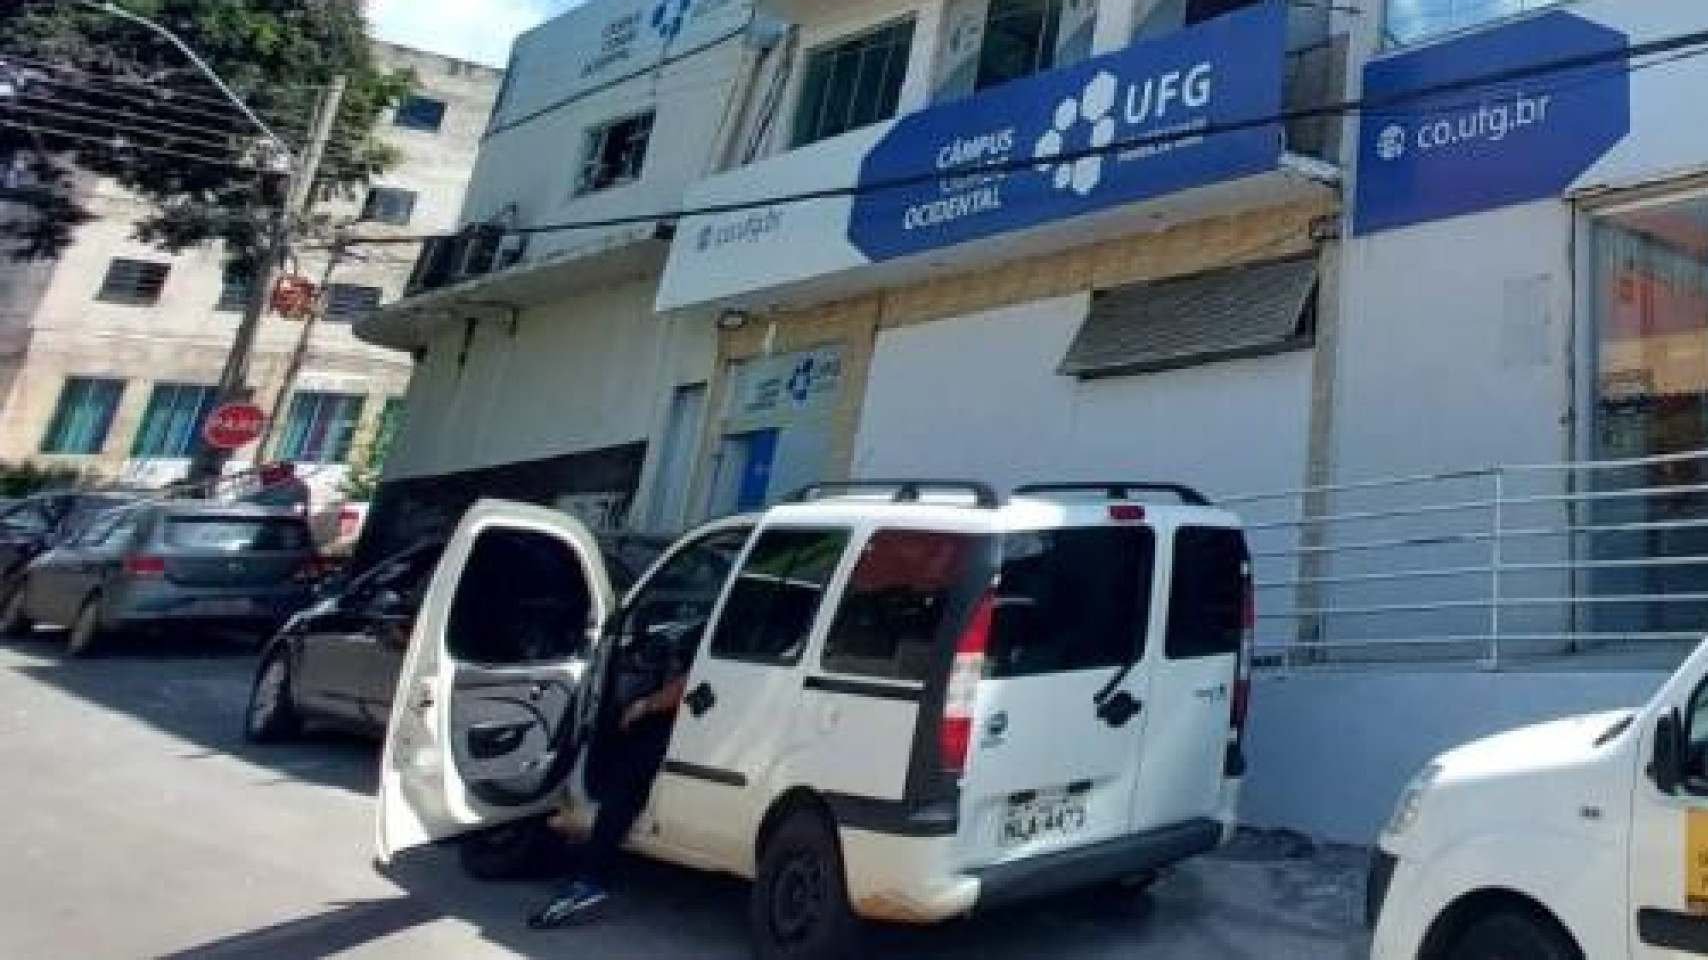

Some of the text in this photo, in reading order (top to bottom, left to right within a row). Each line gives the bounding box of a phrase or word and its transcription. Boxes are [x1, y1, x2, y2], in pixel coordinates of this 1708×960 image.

[1123, 61, 1212, 124] UFG
[1417, 93, 1551, 148] co.ufg.br
[904, 184, 1001, 230] OCIDENTAL
